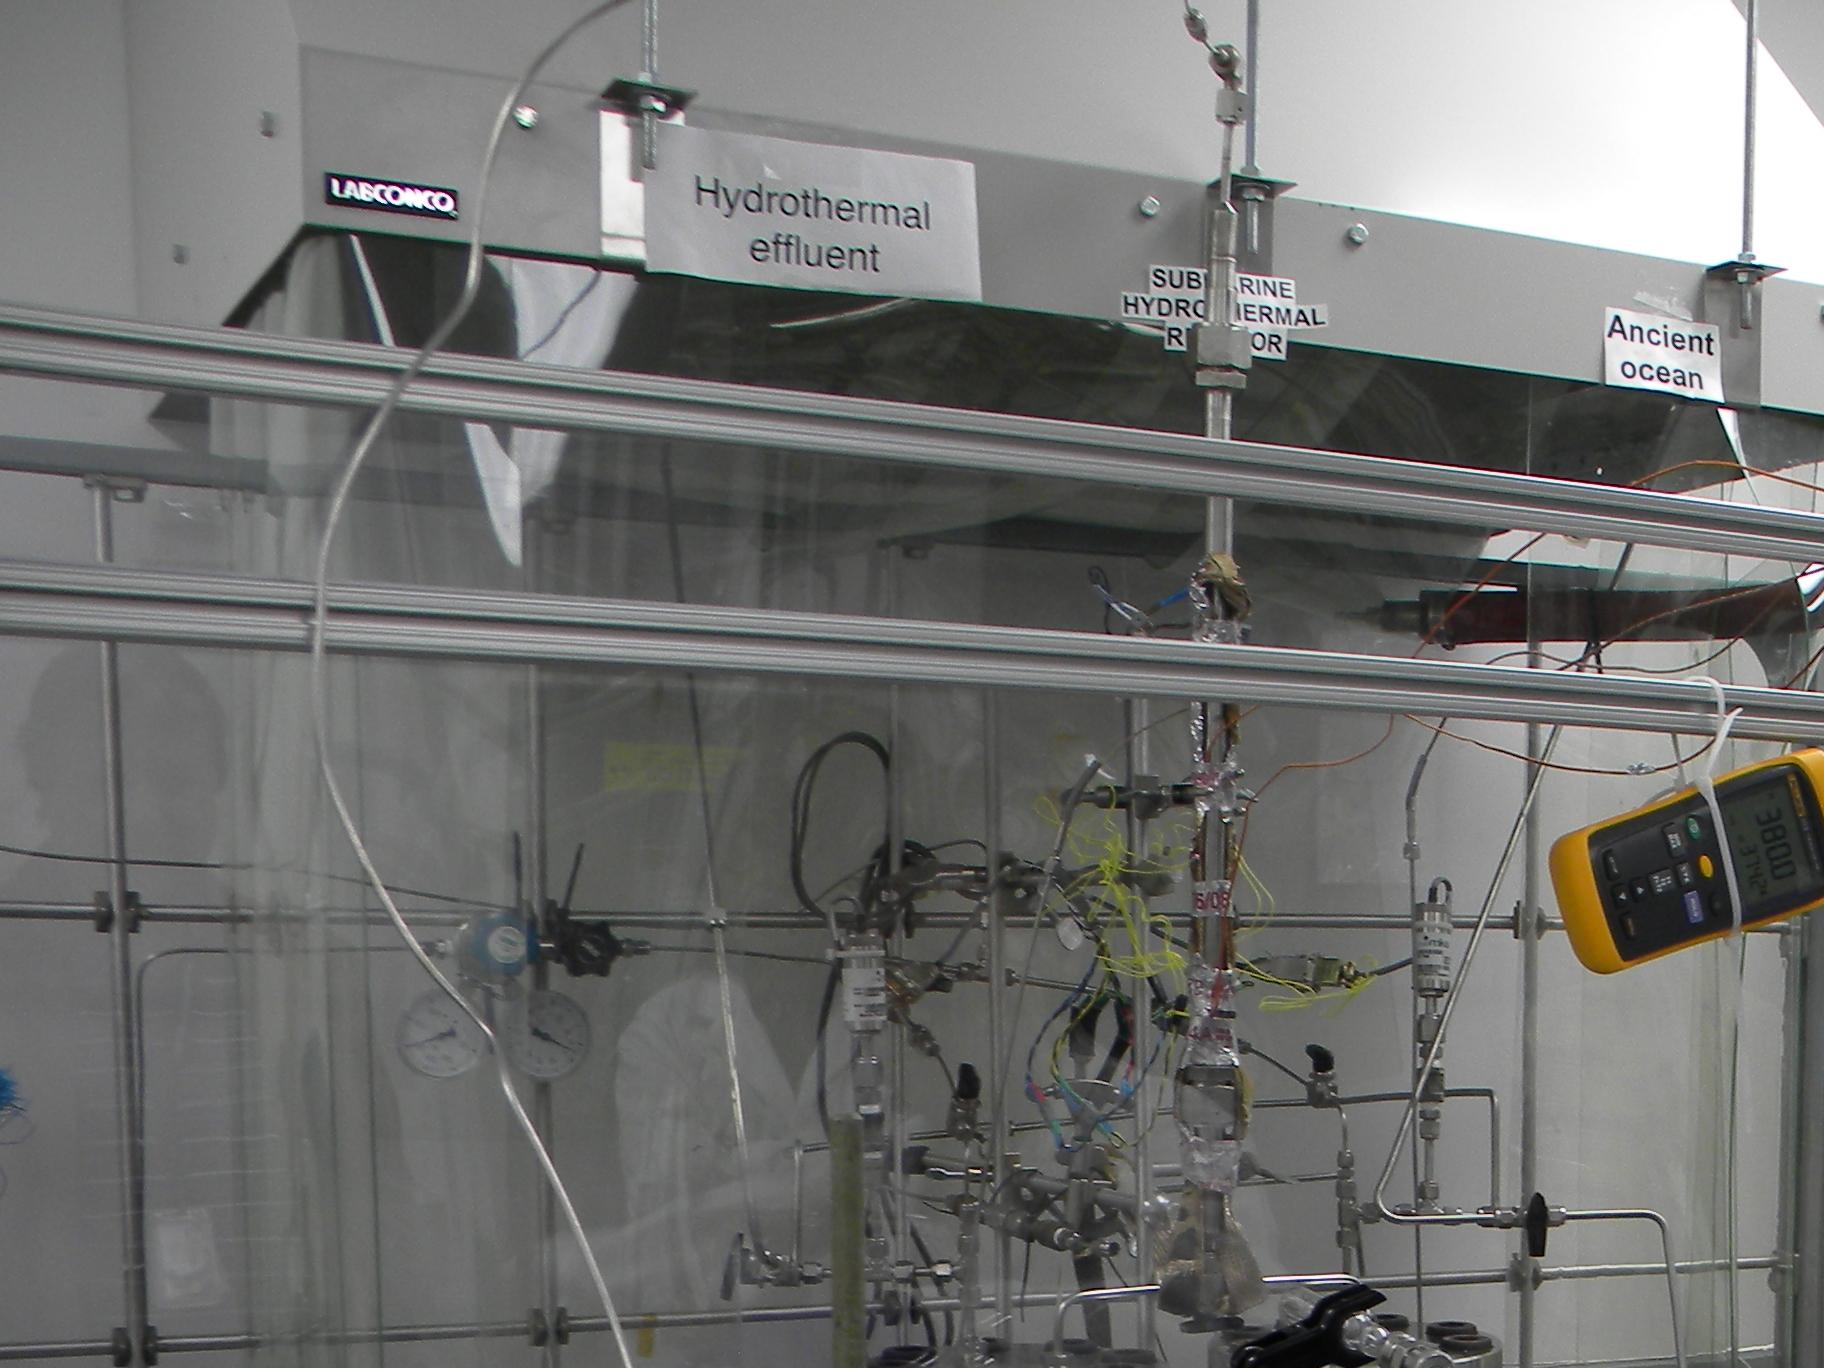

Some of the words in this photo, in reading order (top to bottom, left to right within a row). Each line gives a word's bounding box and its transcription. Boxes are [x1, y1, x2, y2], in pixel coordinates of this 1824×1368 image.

[330, 177, 456, 213] LABCONCO
[694, 175, 931, 230] Hydrothermal
[750, 232, 881, 273] effluent
[1152, 268, 1295, 299] SUBRINE
[1607, 314, 1715, 356] Ancient
[1620, 360, 1704, 390] ocean
